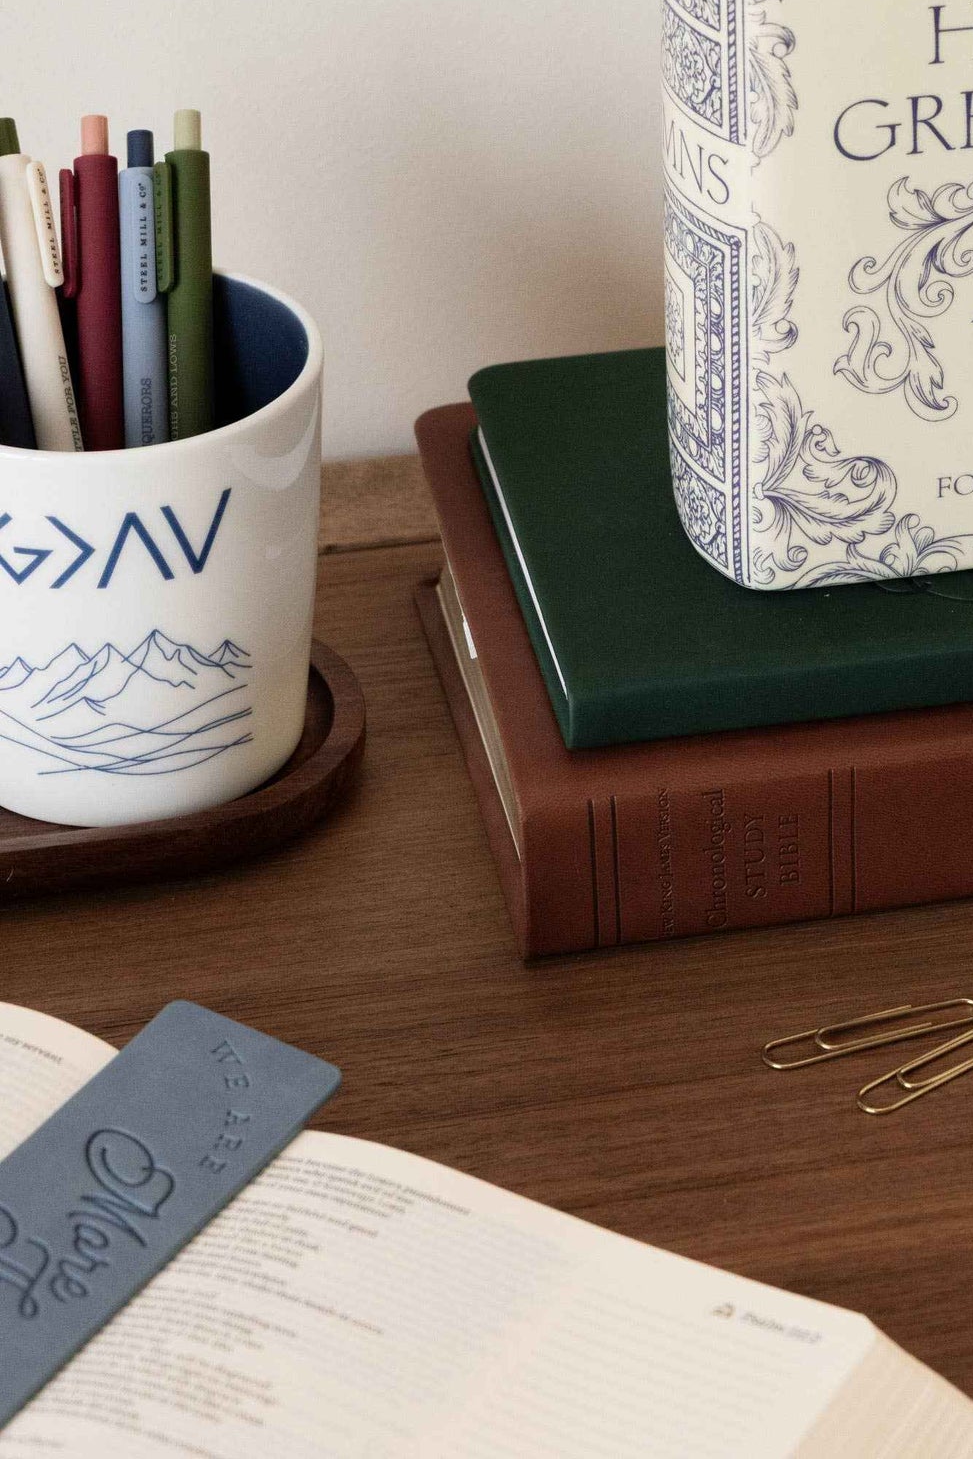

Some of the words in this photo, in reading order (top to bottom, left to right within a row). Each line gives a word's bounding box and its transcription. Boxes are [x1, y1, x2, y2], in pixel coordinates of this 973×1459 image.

[44, 202, 53, 231] MILL
[50, 237, 60, 275] STEEL
[140, 253, 148, 292] STEEL
[58, 355, 70, 383] YOU
[169, 334, 178, 373] LOWS
[64, 387, 76, 415] FOR
[141, 377, 155, 446] QUERORS
[170, 376, 179, 408] AND
[702, 787, 732, 929] Chronological
[743, 813, 768, 900] STUDY
[778, 813, 801, 887] BIBLE
[210, 1038, 251, 1094] WE
[197, 1108, 251, 1176] ARE
